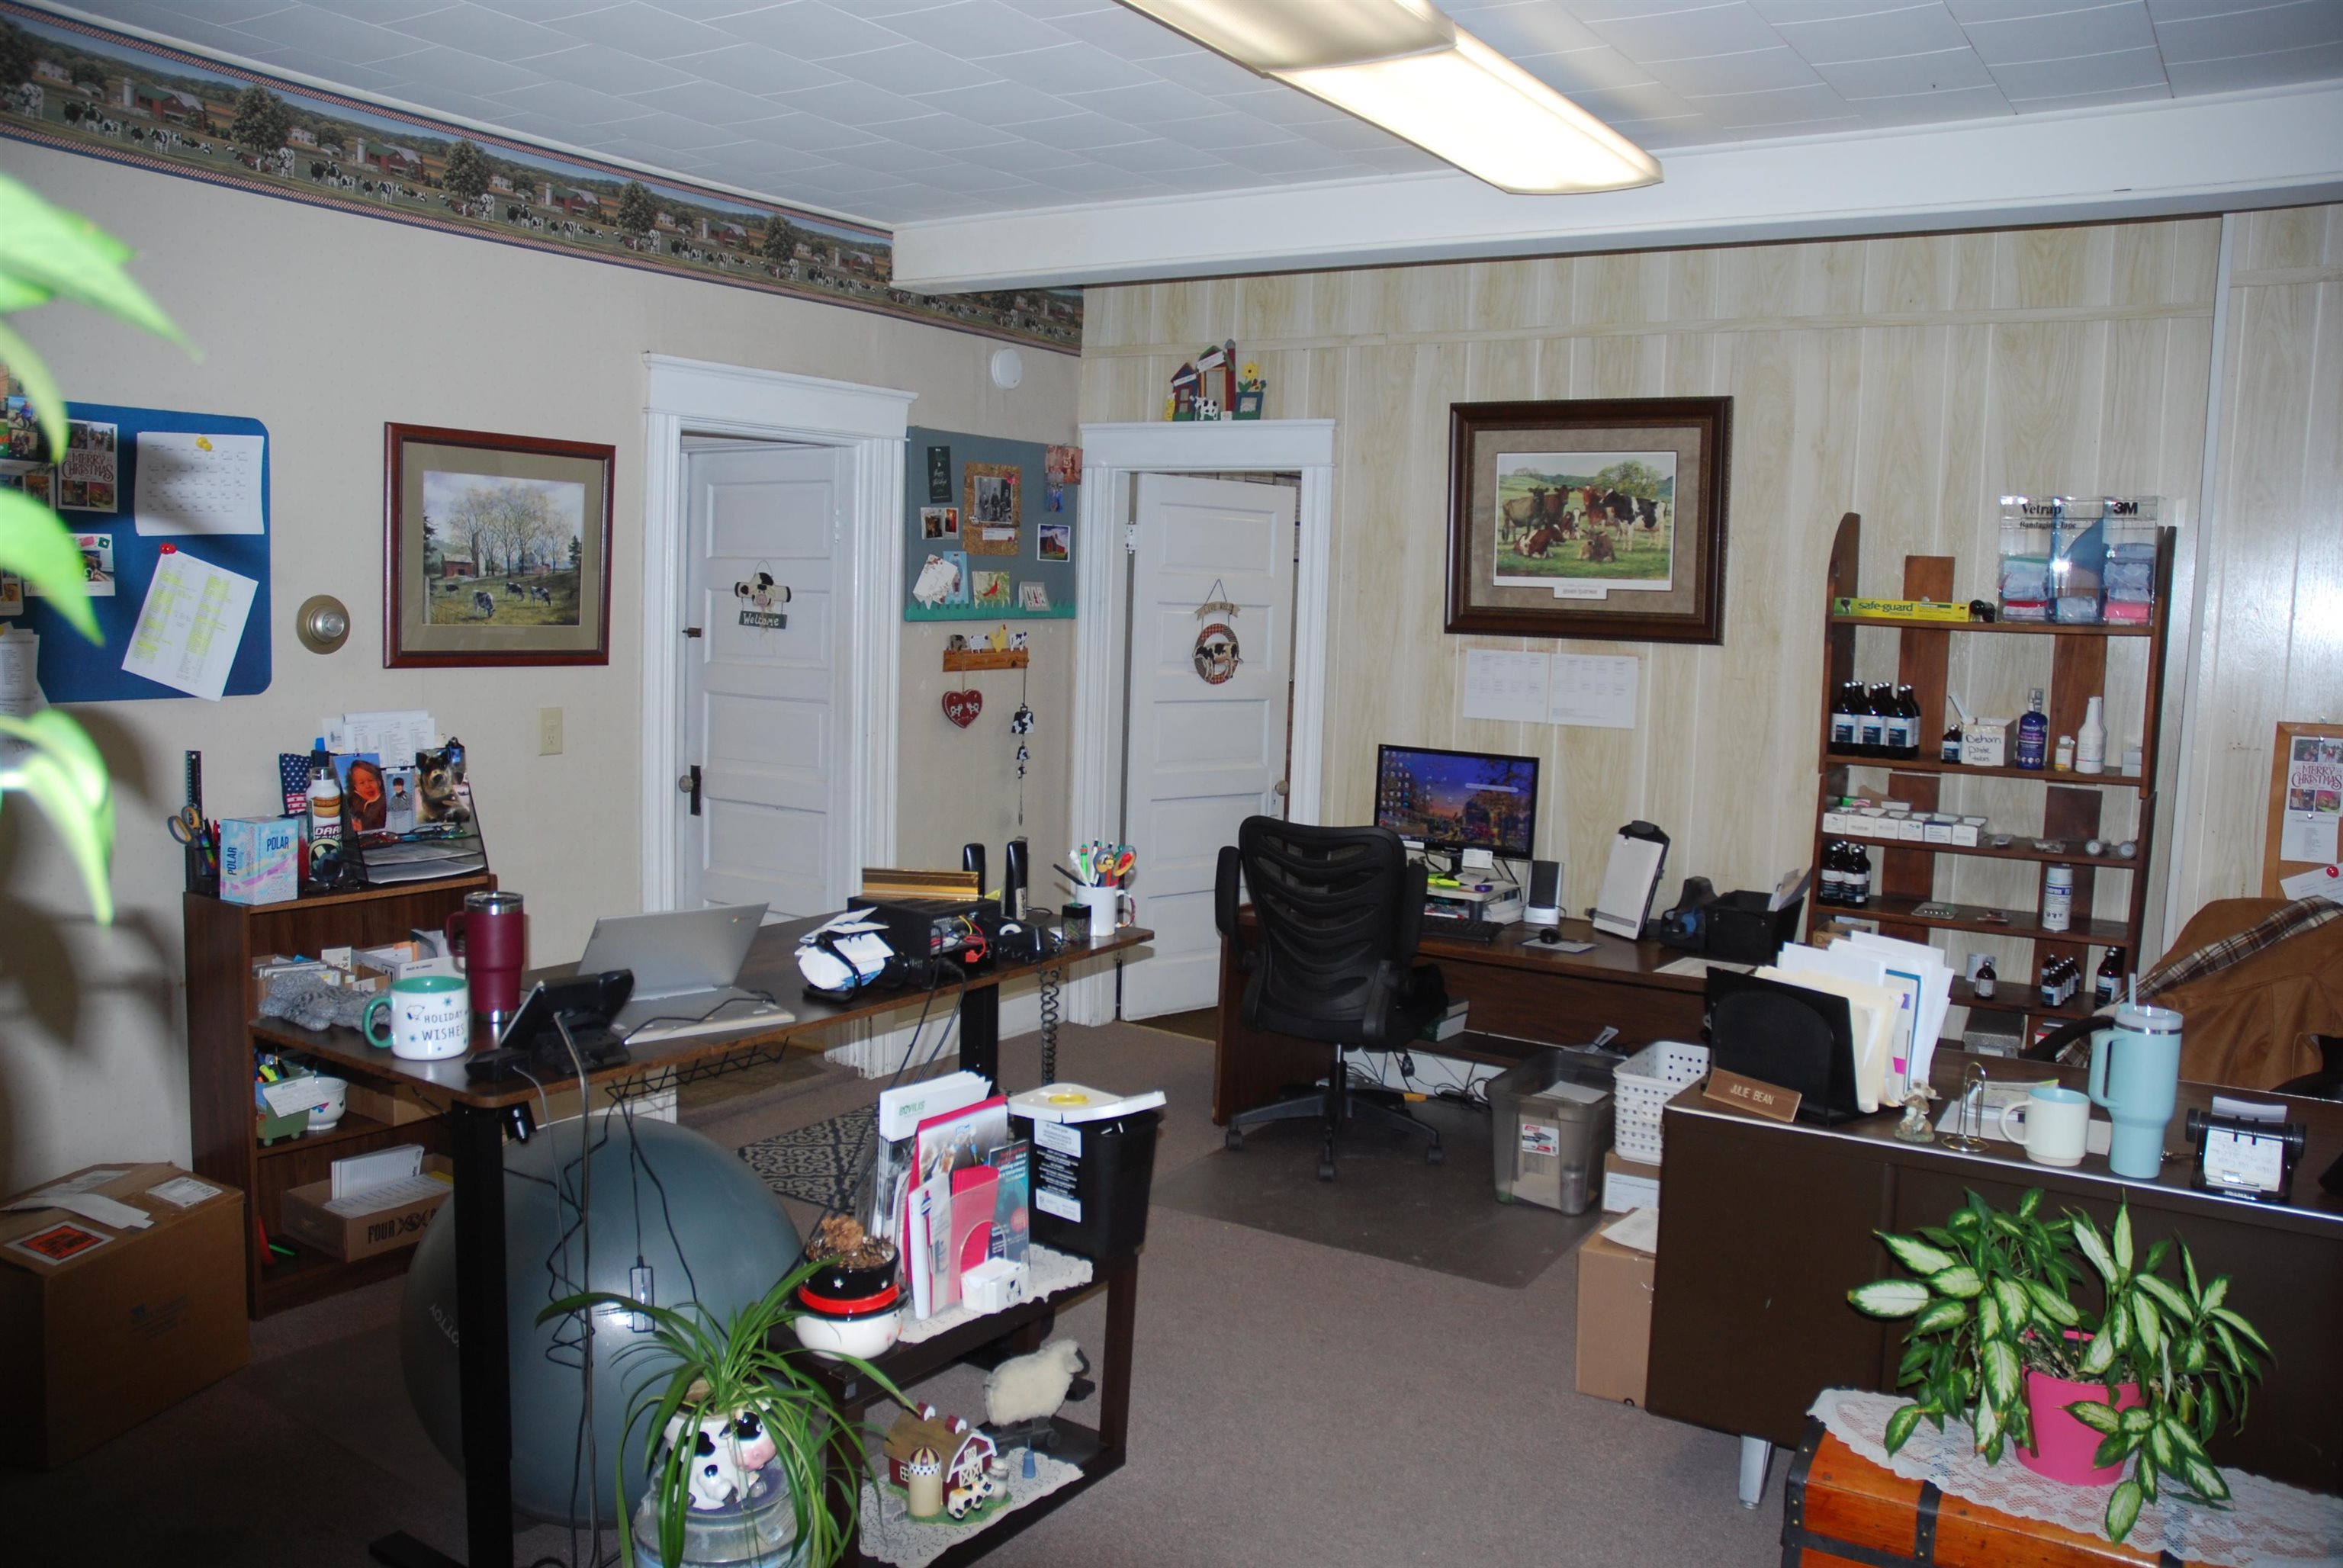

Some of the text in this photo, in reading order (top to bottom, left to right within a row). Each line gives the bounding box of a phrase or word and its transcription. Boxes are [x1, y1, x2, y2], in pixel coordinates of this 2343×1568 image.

[71, 451, 105, 465] MERRY
[62, 460, 114, 482] CHRISTMAS
[2022, 502, 2138, 517] Vetrap 3M
[2060, 522, 2077, 530] Tape
[1858, 600, 1913, 613] safe-guard
[743, 612, 779, 627] Welcome
[2302, 764, 2335, 776] MERRY
[2291, 772, 2342, 790] CHRISTMAS
[266, 836, 289, 852] POLAR
[227, 847, 237, 876] POLAR
[424, 1010, 463, 1023] HOLIDAY
[422, 1024, 464, 1041] WISHES
[1730, 1084, 1775, 1105] JULIE BEAN
[899, 1100, 925, 1116] BOVILIS
[368, 1220, 395, 1245] FOUR
